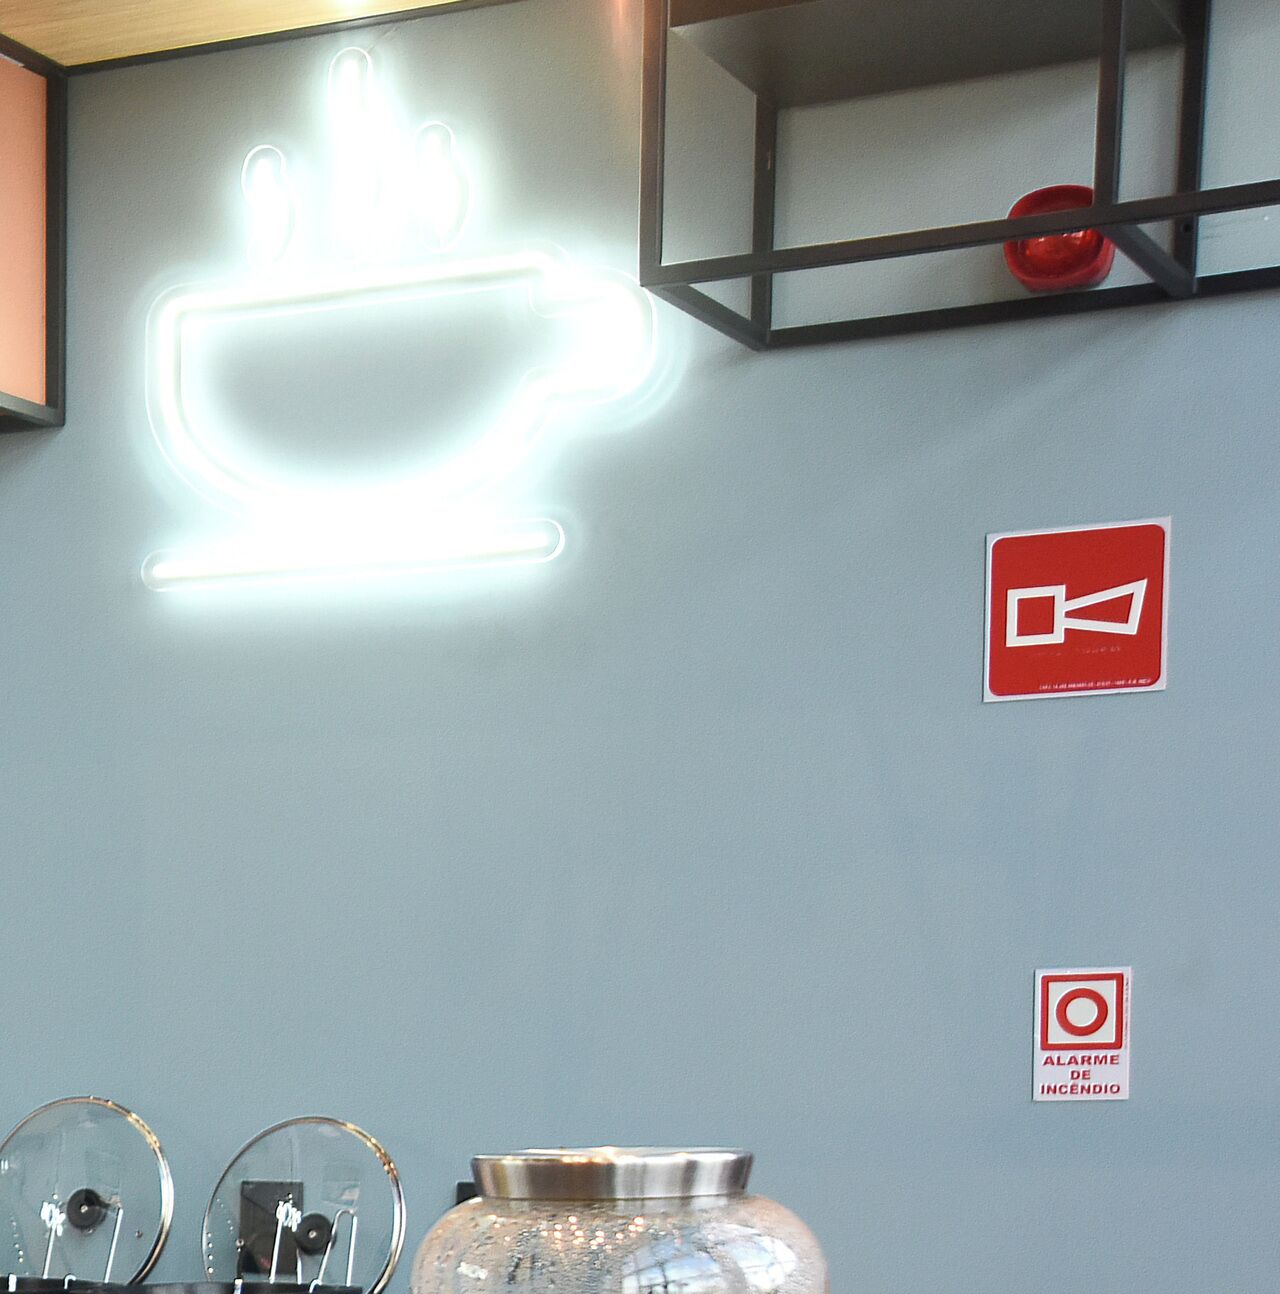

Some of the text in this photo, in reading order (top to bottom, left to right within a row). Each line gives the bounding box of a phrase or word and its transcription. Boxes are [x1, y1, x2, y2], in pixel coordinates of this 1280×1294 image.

[1043, 1055, 1120, 1066] ALARME
[1070, 1070, 1091, 1081] DE
[1040, 1081, 1120, 1095] INCÊNDIO
